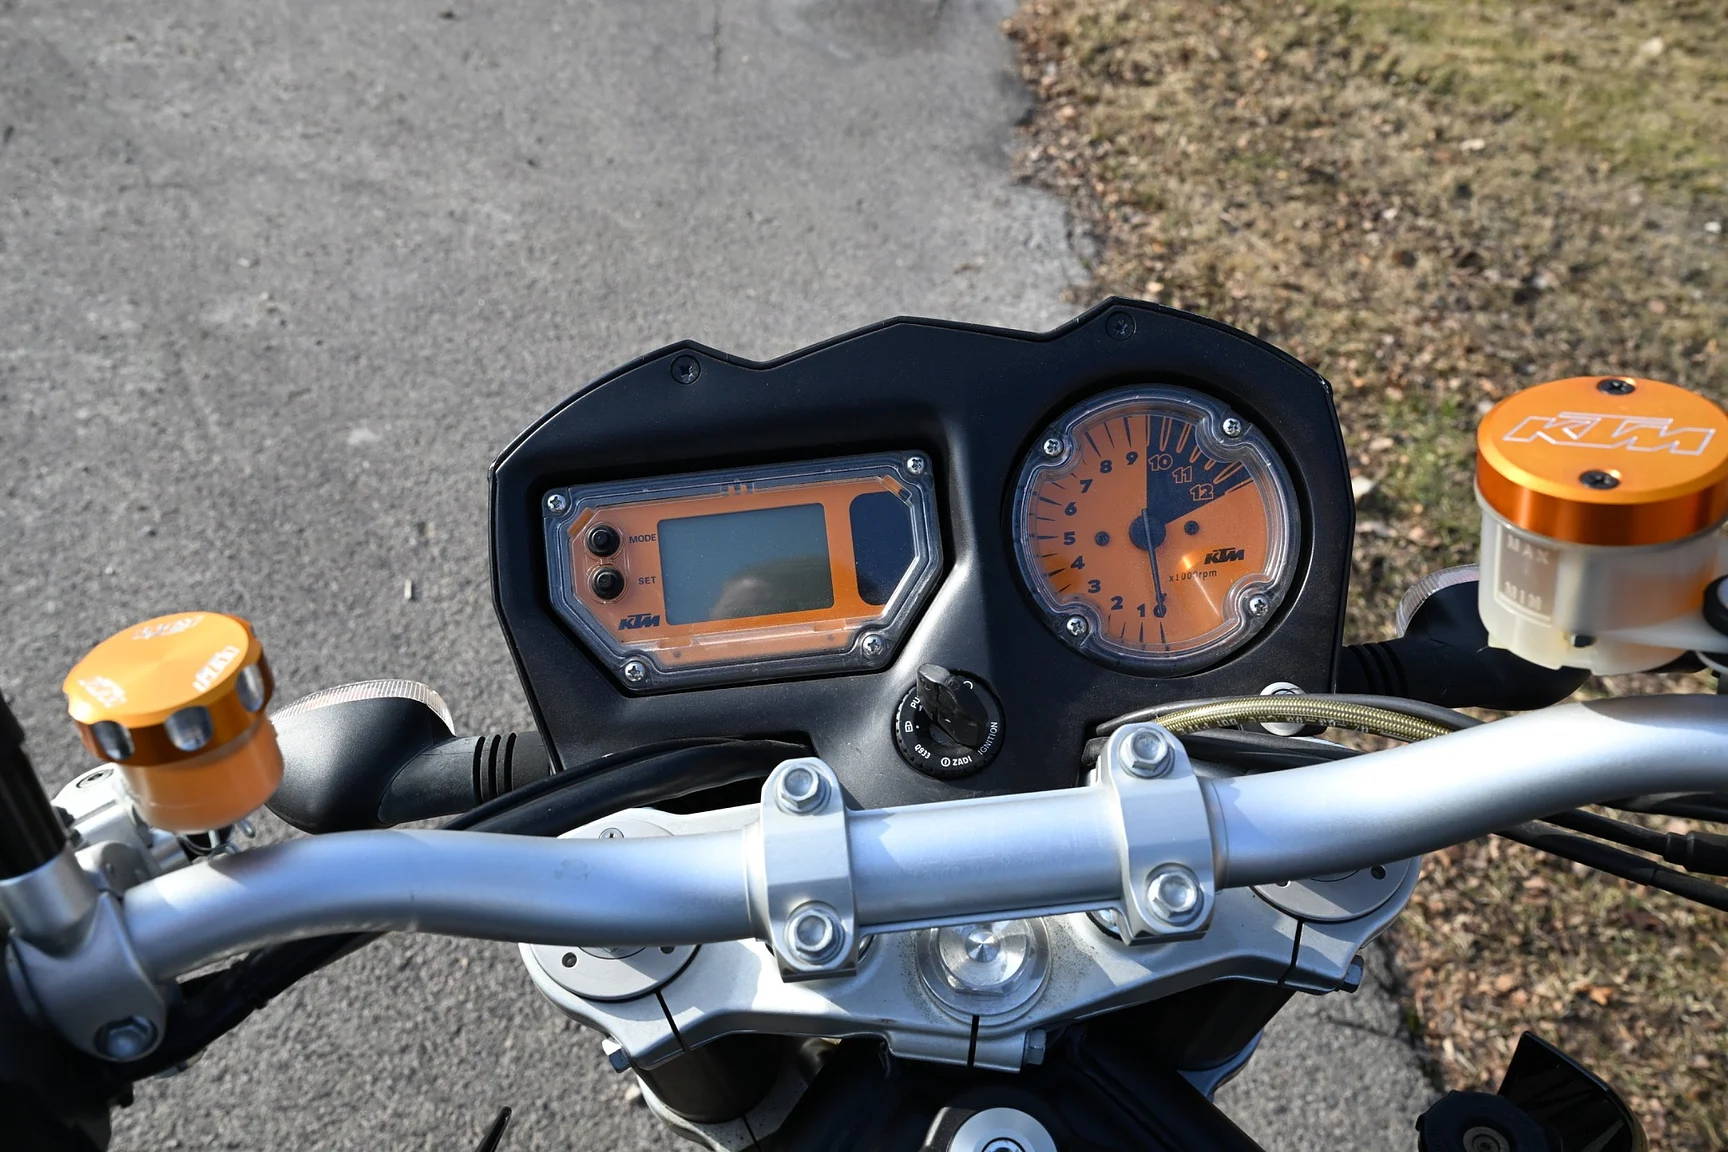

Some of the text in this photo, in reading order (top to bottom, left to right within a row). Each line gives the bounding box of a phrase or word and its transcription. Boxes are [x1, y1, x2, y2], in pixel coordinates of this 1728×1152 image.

[1503, 411, 1717, 456] KTM
[1125, 451, 1138, 466] 9
[1148, 453, 1173, 472] 10
[1099, 460, 1113, 474] 8
[1173, 466, 1193, 484] 11
[1080, 479, 1093, 493] 7
[1190, 483, 1214, 501] 12
[1064, 501, 1078, 516] 6
[629, 534, 657, 544] MODE
[1063, 531, 1076, 545] 5
[1204, 547, 1245, 565] KTM
[1506, 533, 1550, 565] MAX
[1071, 555, 1085, 570] 4
[638, 576, 657, 585] SET
[1088, 580, 1101, 594] 3
[1110, 596, 1124, 610] 2
[1504, 581, 1542, 611] MIN
[1136, 603, 1146, 617] 1
[618, 613, 661, 631] KTM
[910, 697, 920, 709] PU
[977, 722, 998, 755] IGNITION
[952, 756, 973, 766] ZADI
